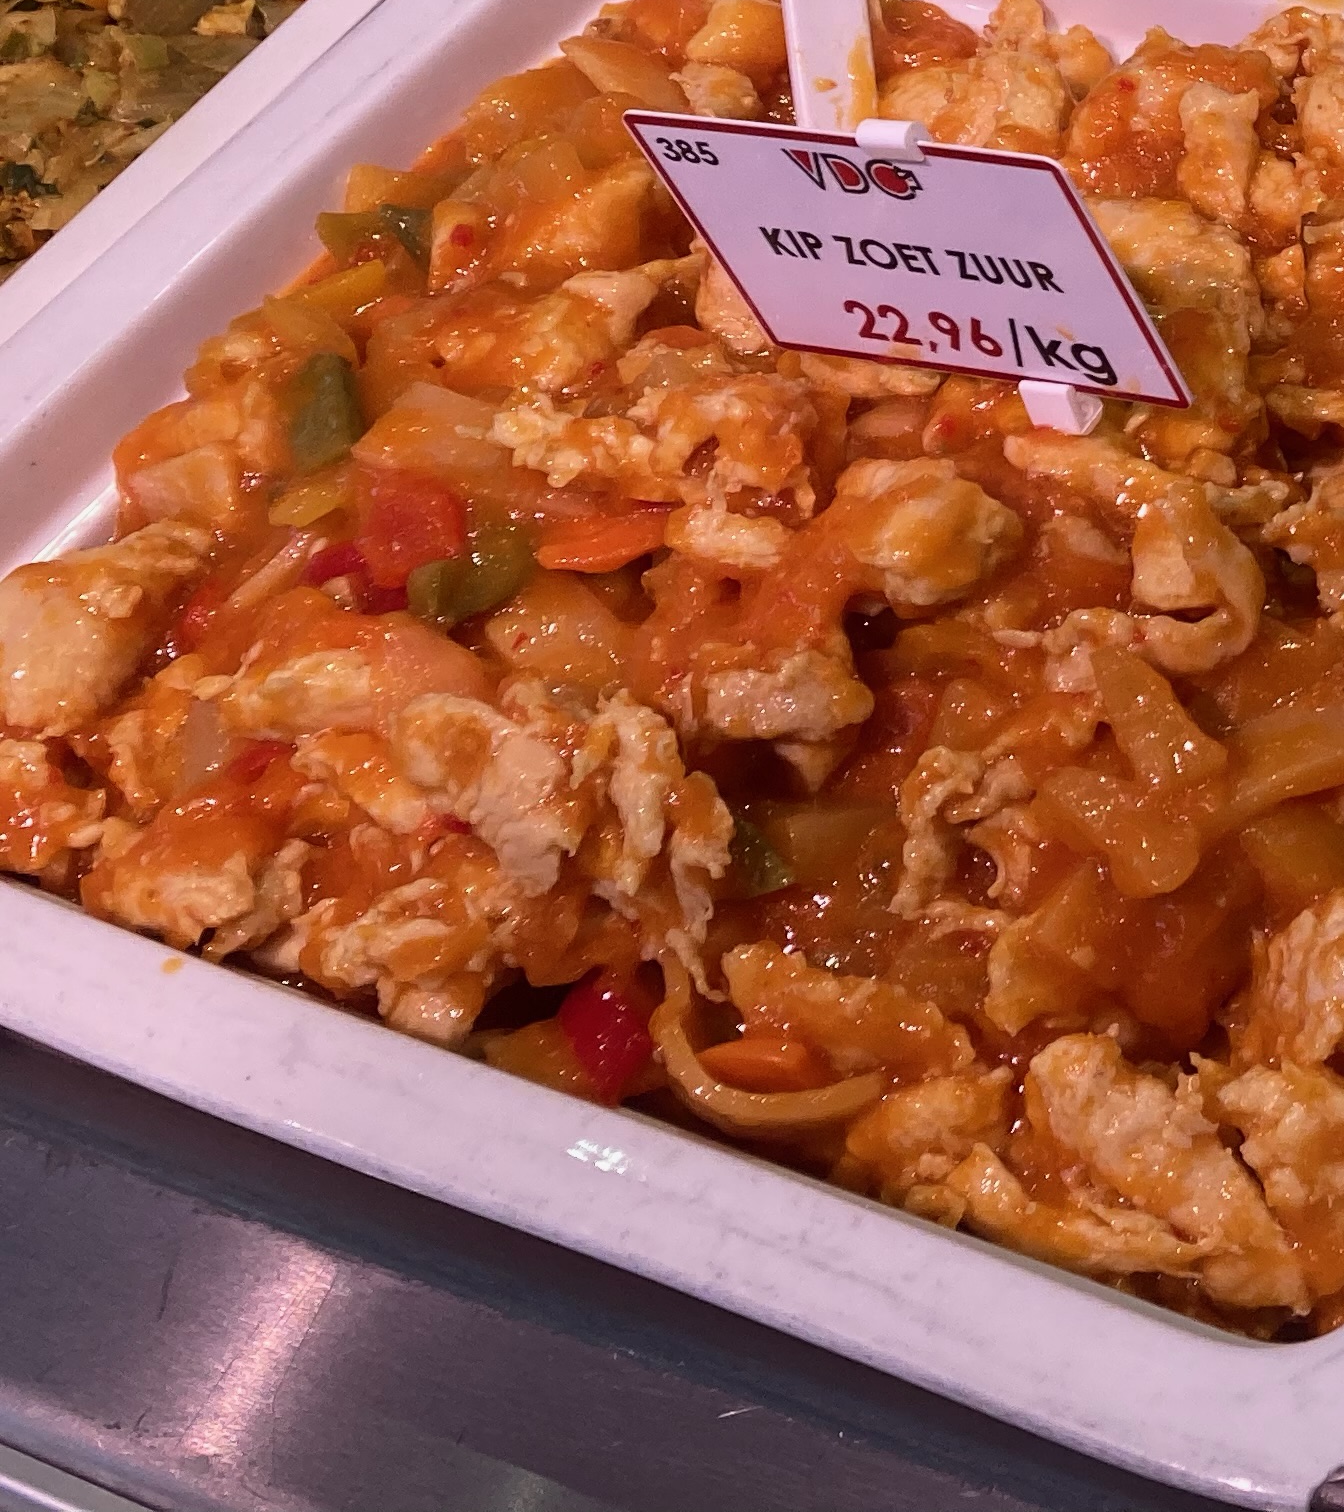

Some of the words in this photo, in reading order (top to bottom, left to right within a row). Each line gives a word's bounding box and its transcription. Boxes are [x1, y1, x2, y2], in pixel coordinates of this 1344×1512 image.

[655, 136, 719, 166] 385
[759, 225, 823, 261] KIP
[833, 235, 941, 277] ZOET
[945, 249, 1064, 294] ZUUR
[843, 299, 1119, 387] 22,96/kg
